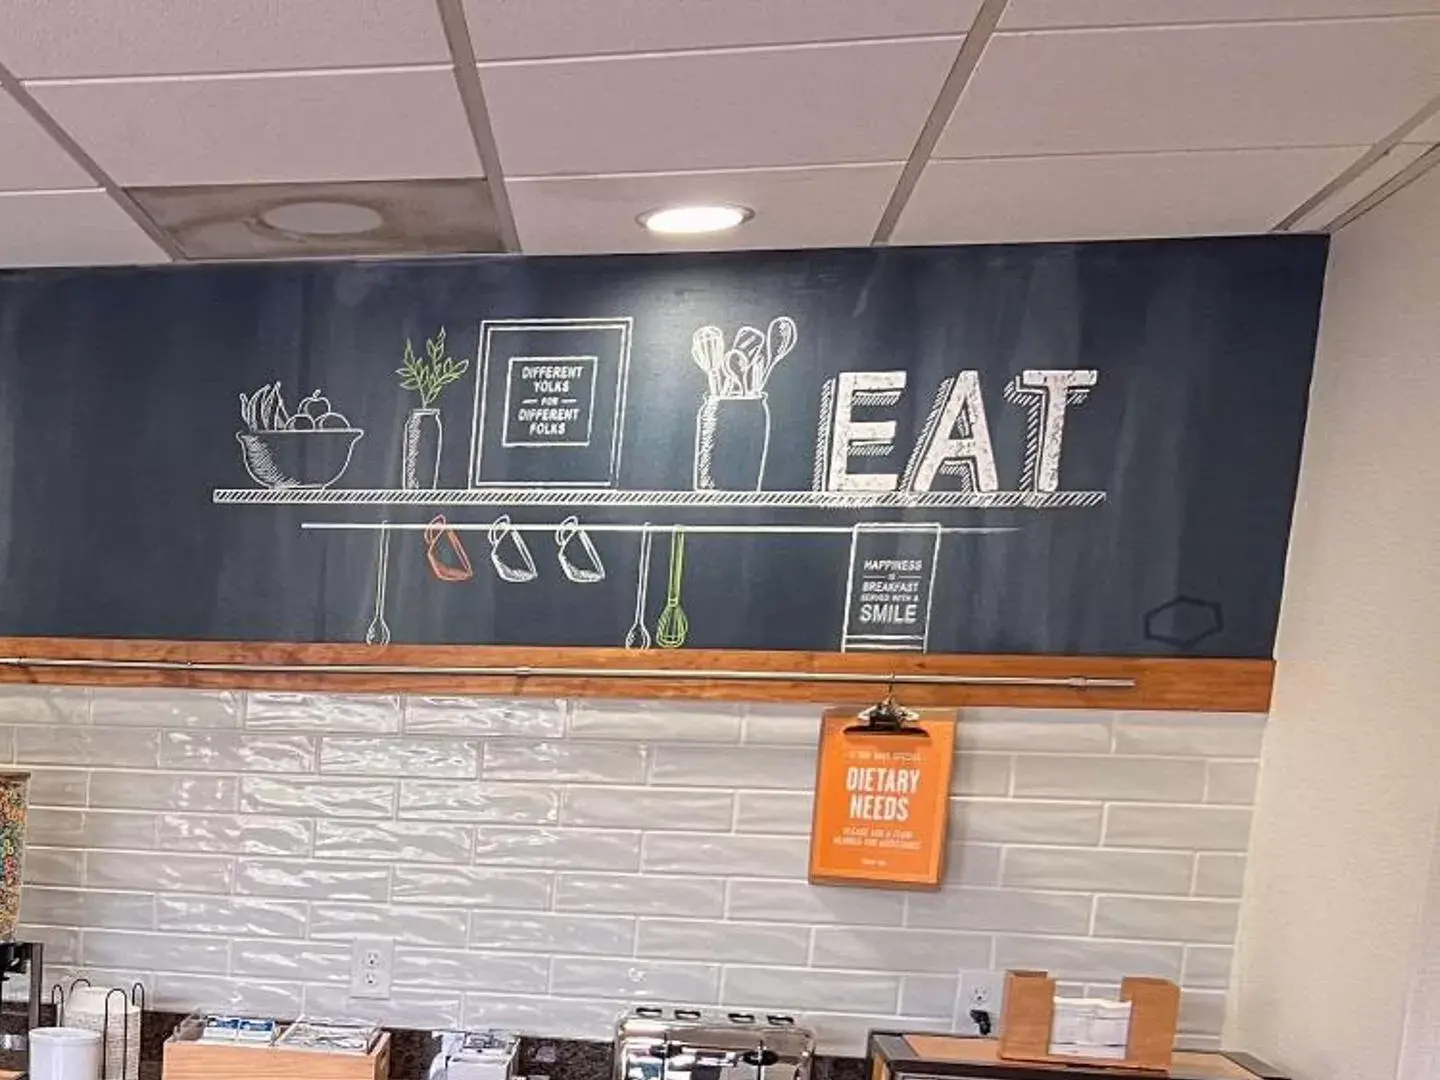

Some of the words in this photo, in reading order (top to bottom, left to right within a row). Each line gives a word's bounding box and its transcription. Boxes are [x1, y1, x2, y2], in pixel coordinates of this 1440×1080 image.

[522, 366, 584, 380] DIFFERENT
[533, 380, 570, 393] YOLKS
[518, 408, 580, 421] DIFFERENT
[529, 422, 565, 436] FOLKS
[815, 370, 1098, 491] EAT
[863, 560, 922, 572] HAPPINESS
[862, 581, 919, 592] BREAKFAST
[860, 603, 918, 624] SMILE
[846, 766, 920, 795] DIETARY
[849, 793, 910, 822] NEEDS
